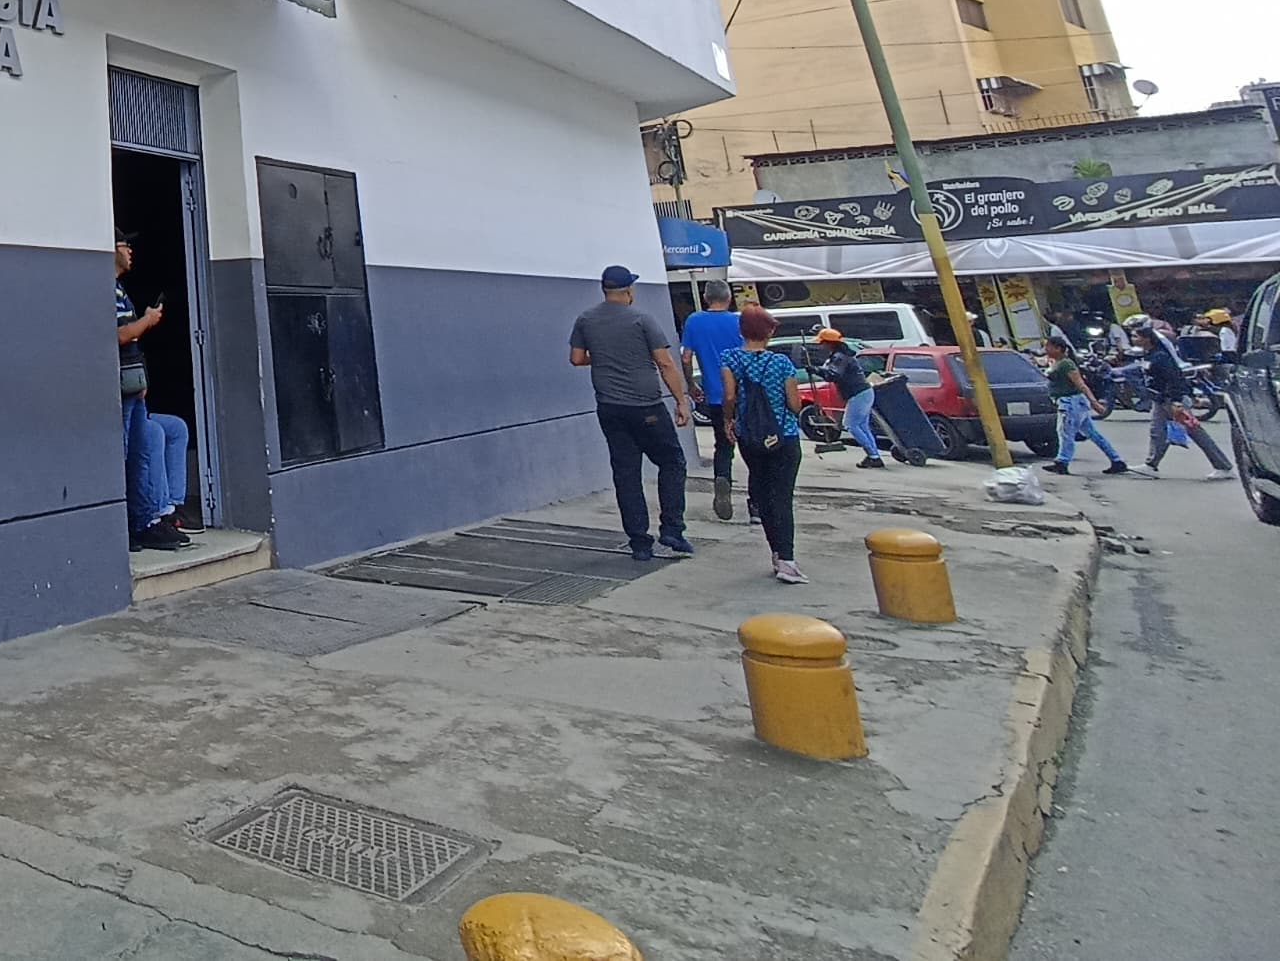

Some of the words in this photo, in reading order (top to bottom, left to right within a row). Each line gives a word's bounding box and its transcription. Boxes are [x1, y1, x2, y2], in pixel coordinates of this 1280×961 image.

[964, 191, 975, 204] El
[977, 190, 1025, 205] granjero
[971, 205, 988, 216] del
[990, 203, 1019, 217] pollo
[1136, 207, 1183, 218] MUCHO
[763, 229, 820, 241] CARNICERÍA
[826, 224, 896, 238] CHARCUTERÍA
